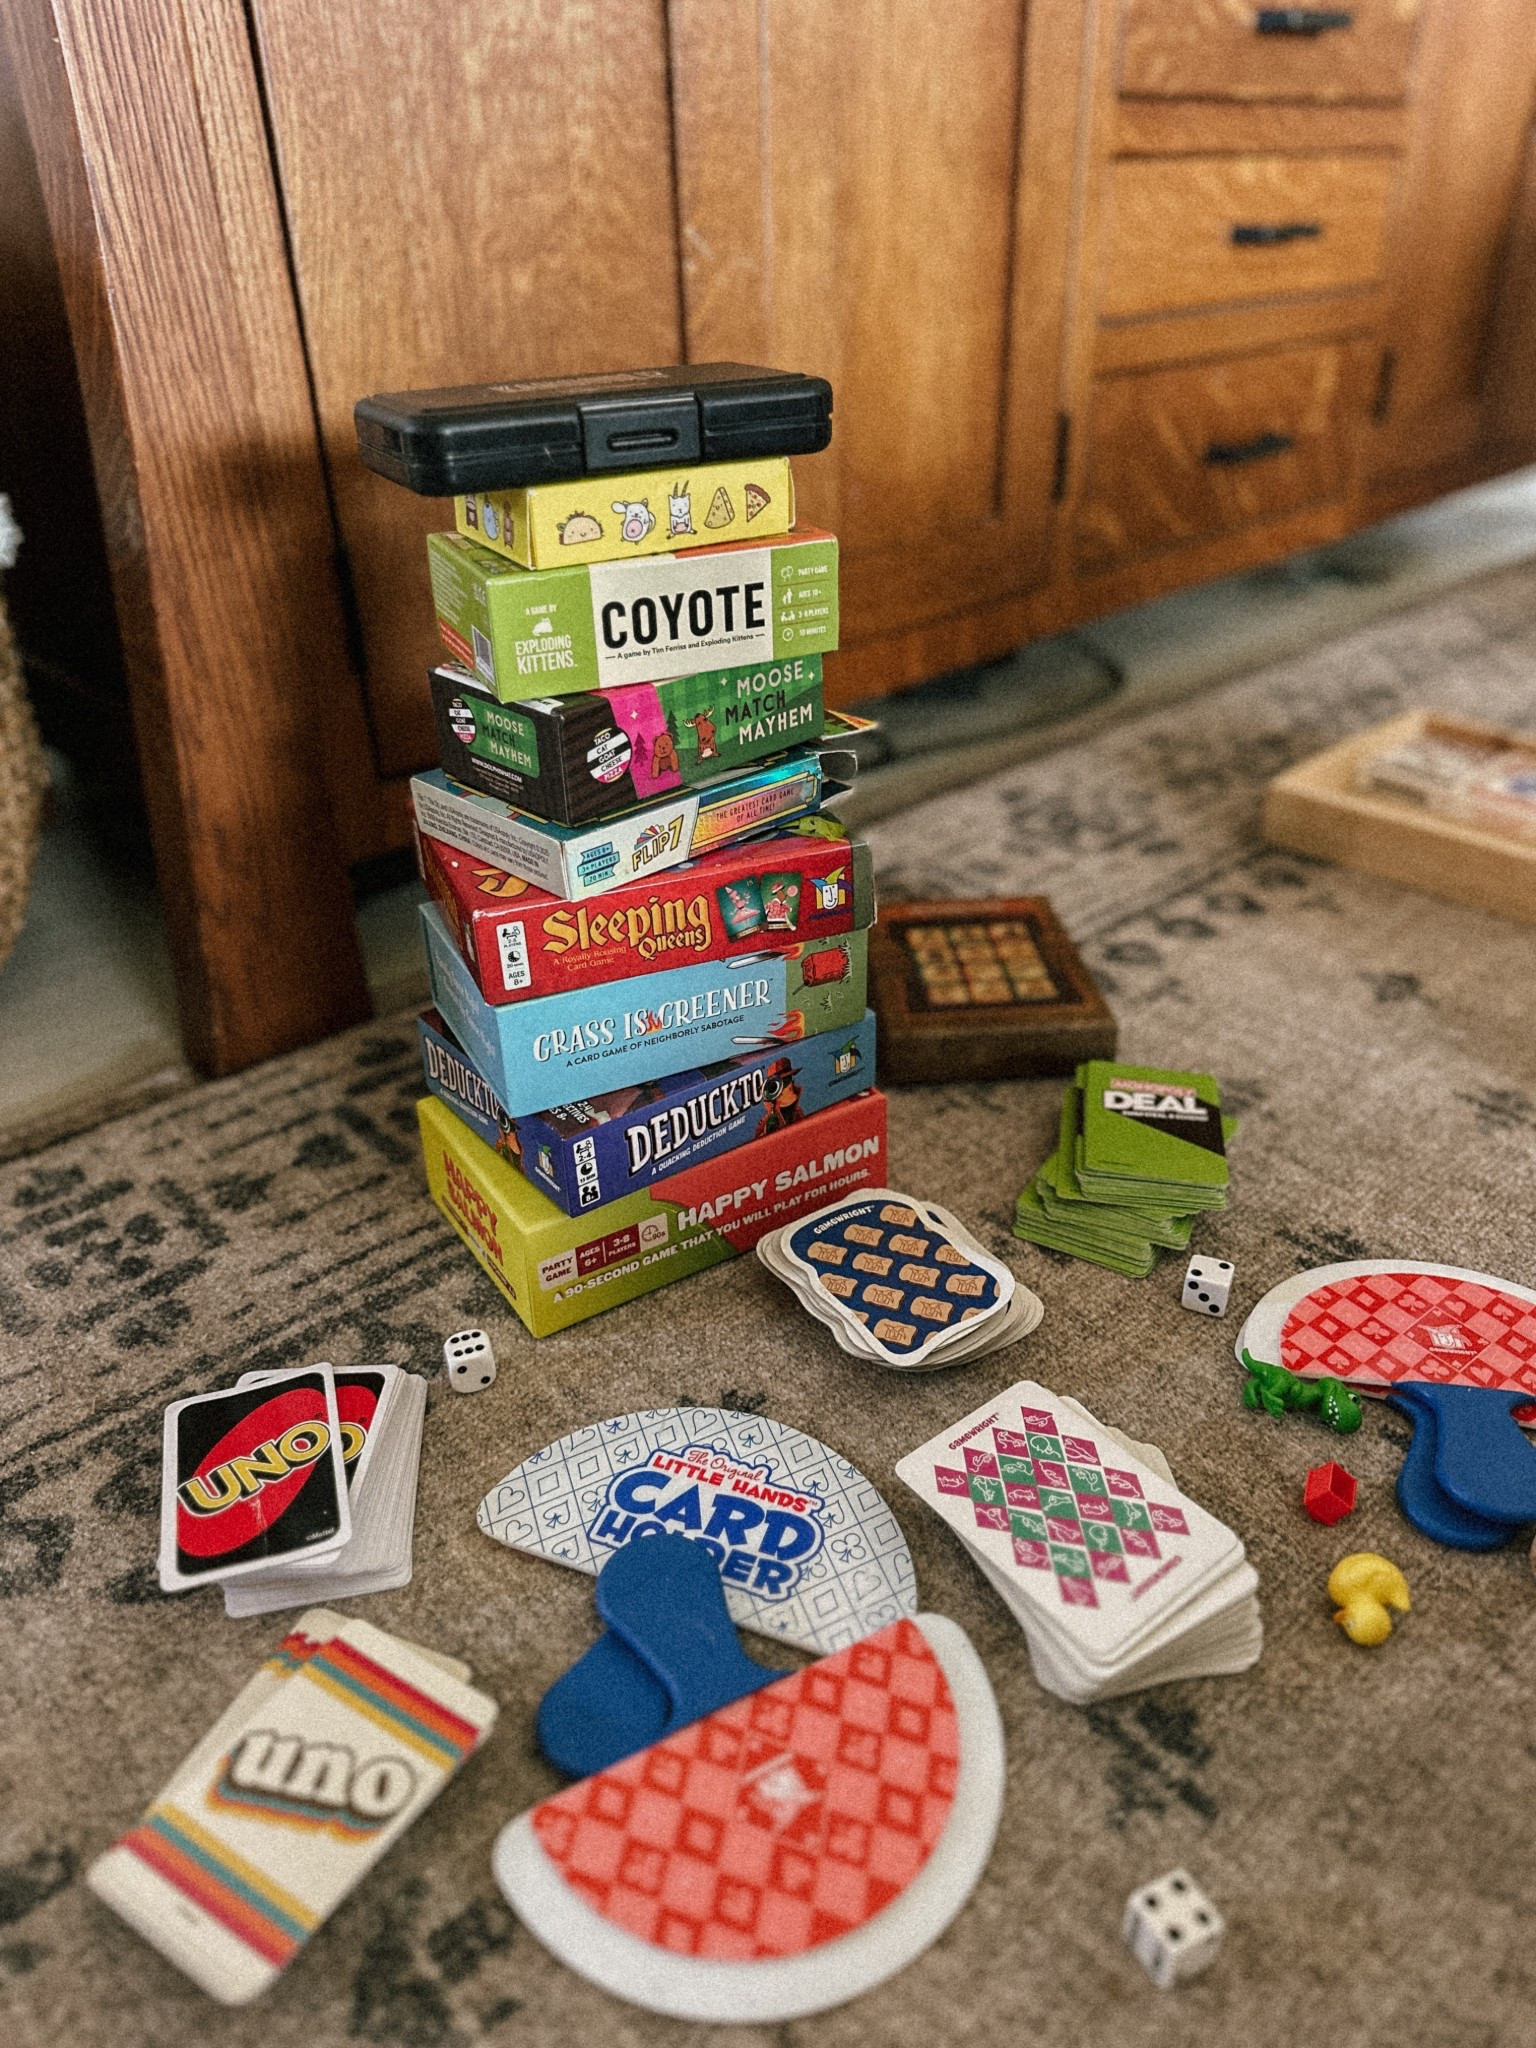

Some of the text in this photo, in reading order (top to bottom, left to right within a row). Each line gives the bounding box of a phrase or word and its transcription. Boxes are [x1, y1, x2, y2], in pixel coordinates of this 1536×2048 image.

[601, 581, 766, 649] COYOTE
[515, 634, 572, 656] EXPLODING
[617, 652, 623, 660] A
[623, 651, 642, 660] game
[651, 646, 665, 654] Tim
[665, 644, 687, 653] Ferriss
[688, 641, 700, 649] and
[700, 637, 732, 648] Exploding
[732, 634, 754, 643] Kittens
[736, 660, 804, 699] MOOSE
[724, 689, 787, 726] MATCH
[486, 710, 525, 736] MOOSE
[738, 702, 813, 745] MAYHEM
[482, 725, 516, 748] MATCH
[593, 732, 611, 746] TACO
[596, 743, 608, 755] CAT
[489, 741, 532, 768] MAYHEM
[598, 749, 616, 763] GOAT
[600, 755, 622, 771] CHEESE
[716, 787, 795, 820] THE GREATEST CARD GAME
[736, 814, 745, 822] OF
[746, 811, 757, 820] ALL
[586, 850, 601, 859] AGES
[631, 814, 685, 872] FLIP 7
[590, 855, 617, 869] PLAYERS
[589, 874, 597, 882] 20
[543, 893, 712, 955] Sleeping
[553, 946, 627, 966] A Royally Rousing
[638, 927, 705, 961] Queens
[508, 970, 526, 980] AGES
[567, 957, 615, 971] Card Game
[532, 978, 772, 1064] GRASS IS GREENER
[565, 1014, 745, 1068] A CARD GAME OF NEIGHBORLY SABOTAGE
[1103, 1089, 1208, 1116] DEAL
[625, 1066, 765, 1177] DEDUCKTO
[578, 1153, 592, 1163] 2-4
[651, 1115, 746, 1176] A QUACKING DEDUCTION GAME
[675, 1135, 881, 1232] HAPPY SALMON
[585, 1193, 595, 1202] 8+
[553, 1168, 871, 1304] A 90-SECOND GAME THAT YOU WILL PLAY FOR HOURS.
[608, 1241, 637, 1257] PLAYERS
[612, 1234, 631, 1247] 3-8
[541, 1256, 573, 1274] PARTY
[580, 1245, 601, 1259] AGES
[584, 1258, 598, 1267] 6+
[545, 1266, 572, 1282] GAME
[177, 1420, 331, 1518] UNO
[687, 1449, 764, 1481] The Original
[652, 1454, 808, 1513] LITTLE HANDS
[614, 1469, 816, 1561] CARD
[232, 1728, 420, 1822] uno
